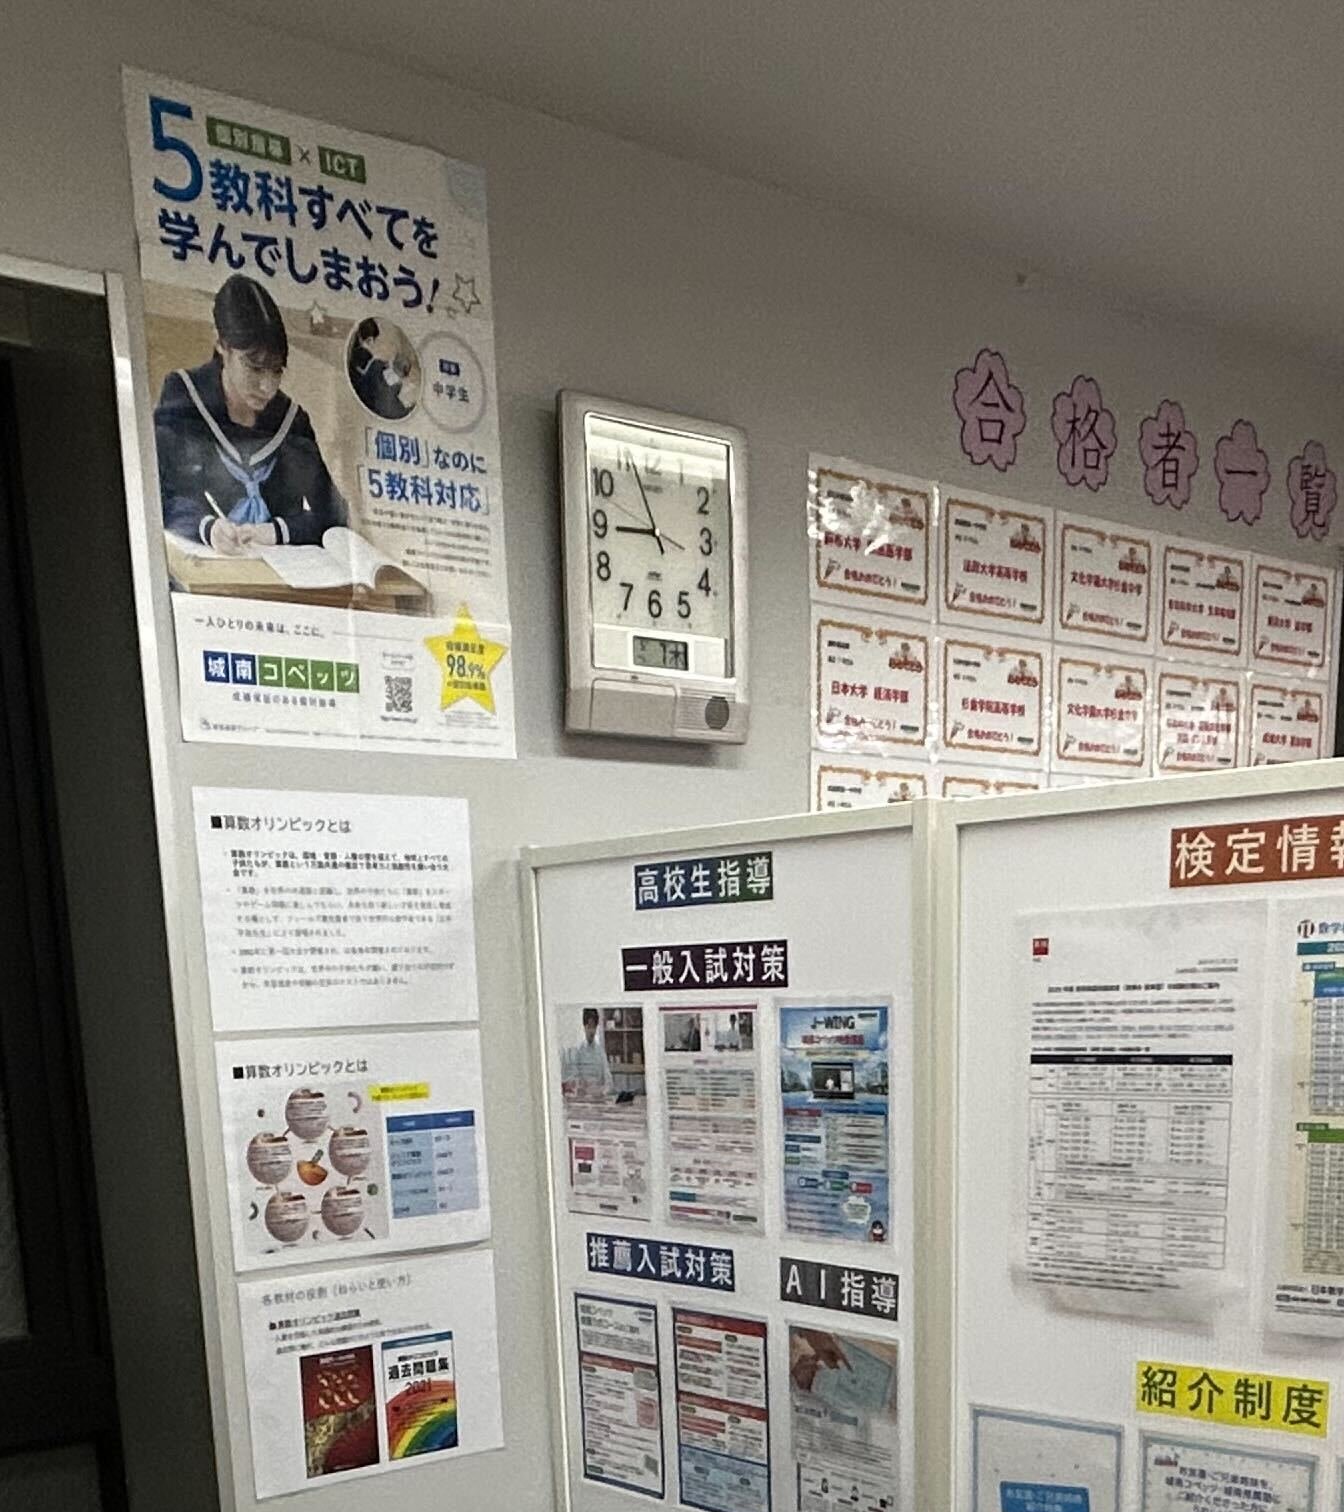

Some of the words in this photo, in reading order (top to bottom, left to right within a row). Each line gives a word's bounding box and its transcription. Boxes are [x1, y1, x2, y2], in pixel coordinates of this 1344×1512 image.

[148, 95, 440, 259] 5教科すべてを
[325, 151, 360, 178] ICT
[432, 382, 470, 404] 中学生
[968, 368, 1327, 529] 合格者一覧
[358, 465, 490, 516] 「5教科対応」
[593, 467, 614, 499] 10
[697, 486, 710, 515] 2
[593, 508, 607, 539] 9
[700, 528, 713, 556] 3
[597, 550, 611, 581] 8
[620, 582, 634, 611] 7
[699, 568, 711, 597] 4
[649, 590, 662, 619] 6
[678, 591, 691, 619] 5
[208, 655, 357, 691] 城南コベッツ
[445, 655, 486, 680] 98.9%
[223, 815, 352, 833] 算数オリンピックとは
[637, 856, 771, 905] 高校生指導
[625, 943, 787, 985] 一般入試対策
[246, 1060, 368, 1079] 算数オリンピックとは
[589, 1238, 733, 1287] 推薦入試対策
[1141, 1366, 1324, 1429] 紹介制度
